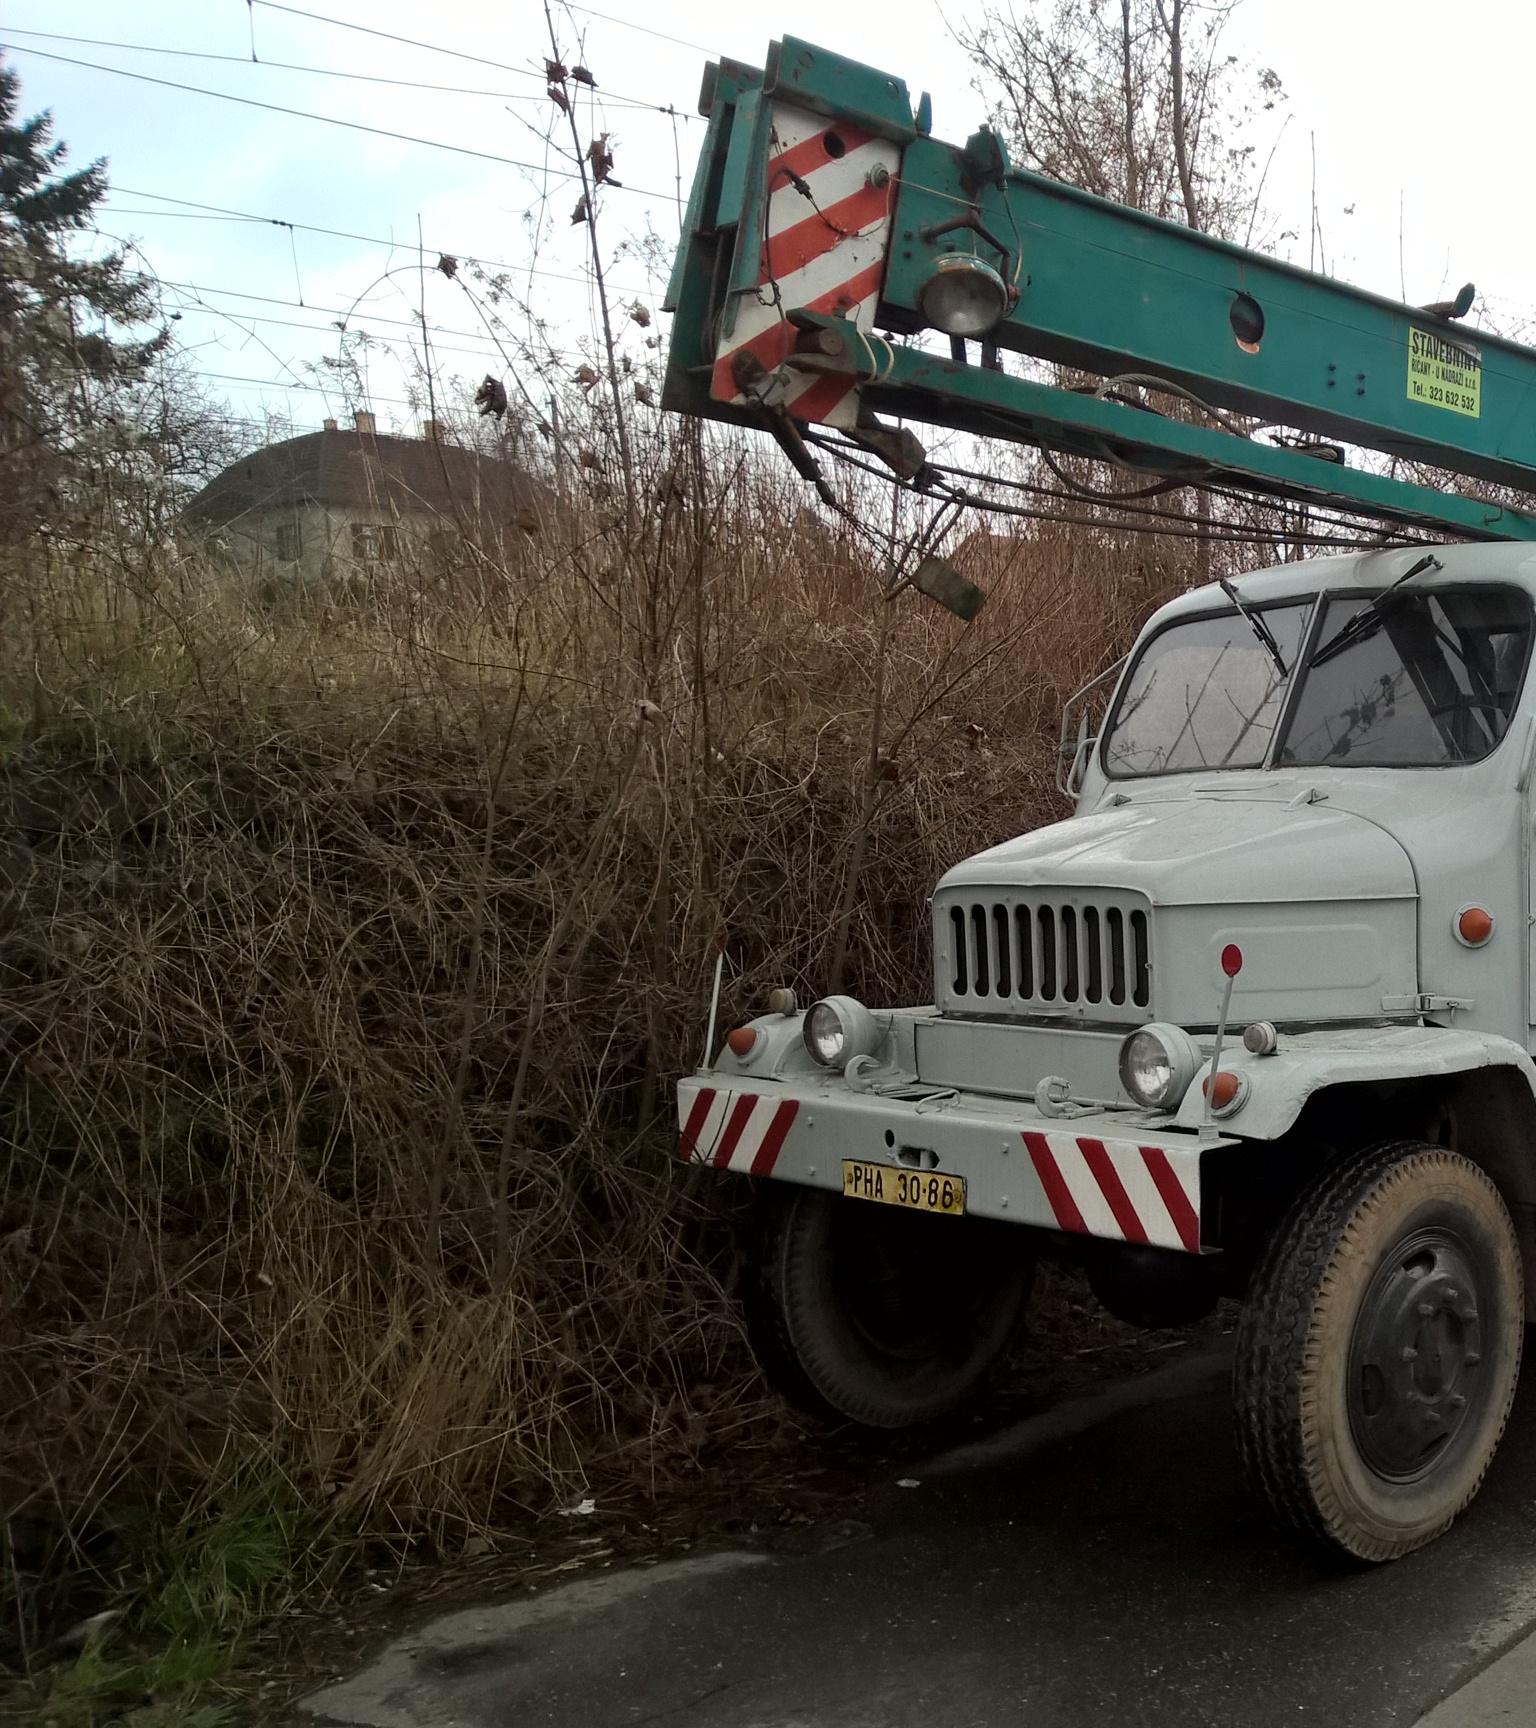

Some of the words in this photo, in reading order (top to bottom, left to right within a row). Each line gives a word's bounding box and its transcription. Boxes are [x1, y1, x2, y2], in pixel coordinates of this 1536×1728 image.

[1412, 331, 1477, 372] STAVEBNINY
[1435, 366, 1440, 379] U
[1429, 386, 1443, 402] 323
[1445, 390, 1460, 407] 632
[1461, 395, 1475, 411] 532
[853, 1165, 884, 1198] PHA
